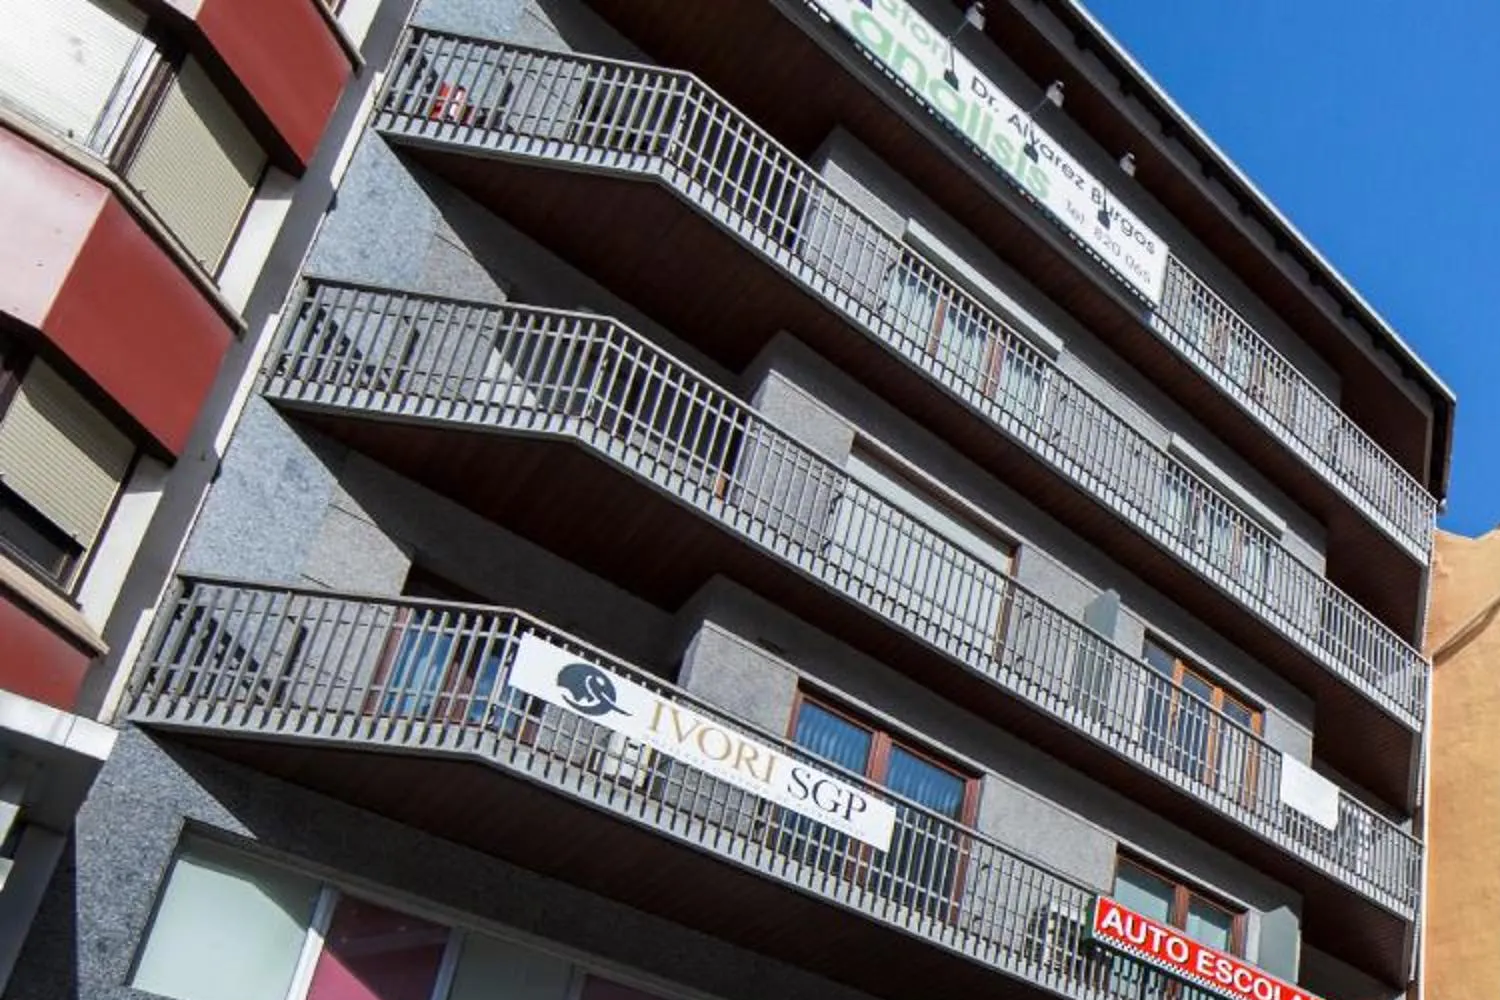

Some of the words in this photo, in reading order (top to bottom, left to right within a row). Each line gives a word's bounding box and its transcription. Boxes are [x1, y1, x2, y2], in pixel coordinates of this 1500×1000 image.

[971, 76, 1000, 113] Dr.
[647, 700, 779, 785] IVORI
[786, 766, 867, 822] SGP
[1100, 907, 1189, 963] AUTO
